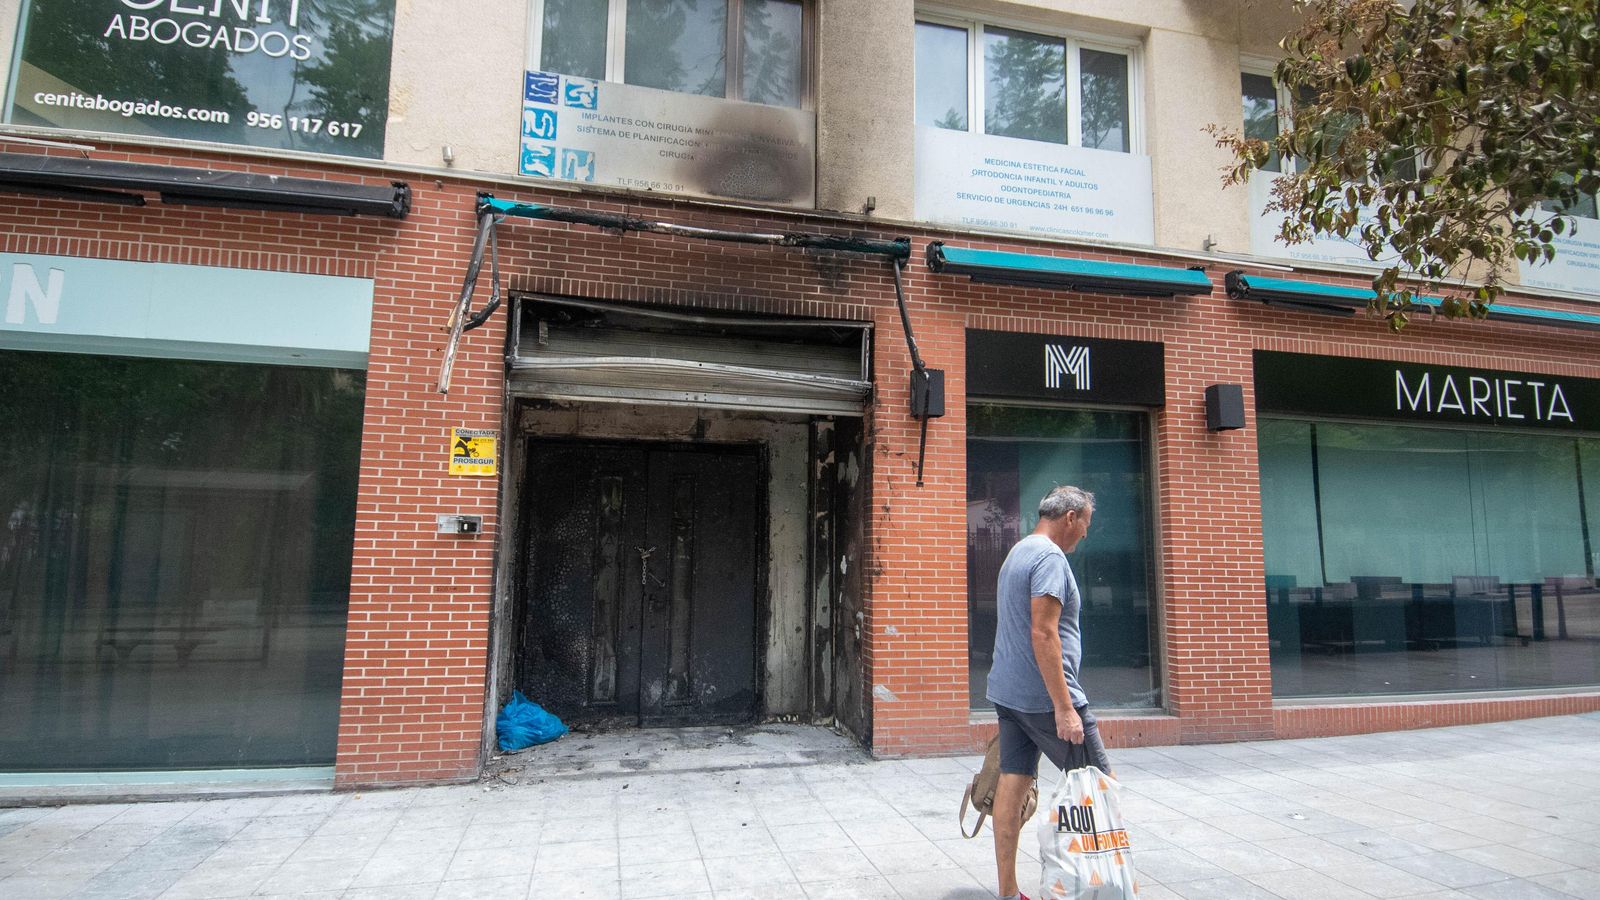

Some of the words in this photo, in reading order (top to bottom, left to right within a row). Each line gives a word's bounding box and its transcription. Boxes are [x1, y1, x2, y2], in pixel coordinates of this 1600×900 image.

[104, 14, 312, 60] ABOGADOS
[34, 90, 230, 124] cenitabogados.com
[247, 111, 282, 130] 956
[289, 116, 322, 134] 117
[327, 120, 362, 138] 617
[582, 112, 633, 126] IMPLANTES
[635, 119, 655, 129] CON
[657, 122, 692, 133] CIRUGIA
[577, 125, 616, 137] SISTEMA
[618, 130, 631, 139] DE
[633, 133, 700, 148] PLANIFICACION
[659, 149, 695, 161] CIRUGIA
[984, 157, 1021, 169] MEDICINA
[1023, 162, 1059, 174] ESTETICA
[1060, 167, 1086, 177] FACIAL
[971, 168, 1023, 181] ORTODONCIA
[1024, 175, 1057, 186] INFANTIL
[1065, 180, 1099, 191] ADULTOS
[1000, 184, 1072, 200] ODONTOPEDIATRIA
[956, 192, 992, 203] SERVICIO
[994, 196, 1005, 204] DE
[1006, 197, 1051, 209] URGENCIAS
[1053, 203, 1068, 212] 24H
[1070, 205, 1083, 214] 651
[1085, 207, 1094, 215] 96
[1095, 208, 1104, 216] 96
[1105, 208, 1114, 217] 96
[1045, 344, 1090, 390] M
[1395, 369, 1574, 422] MARIETA
[453, 457, 494, 465] PROSEGUR
